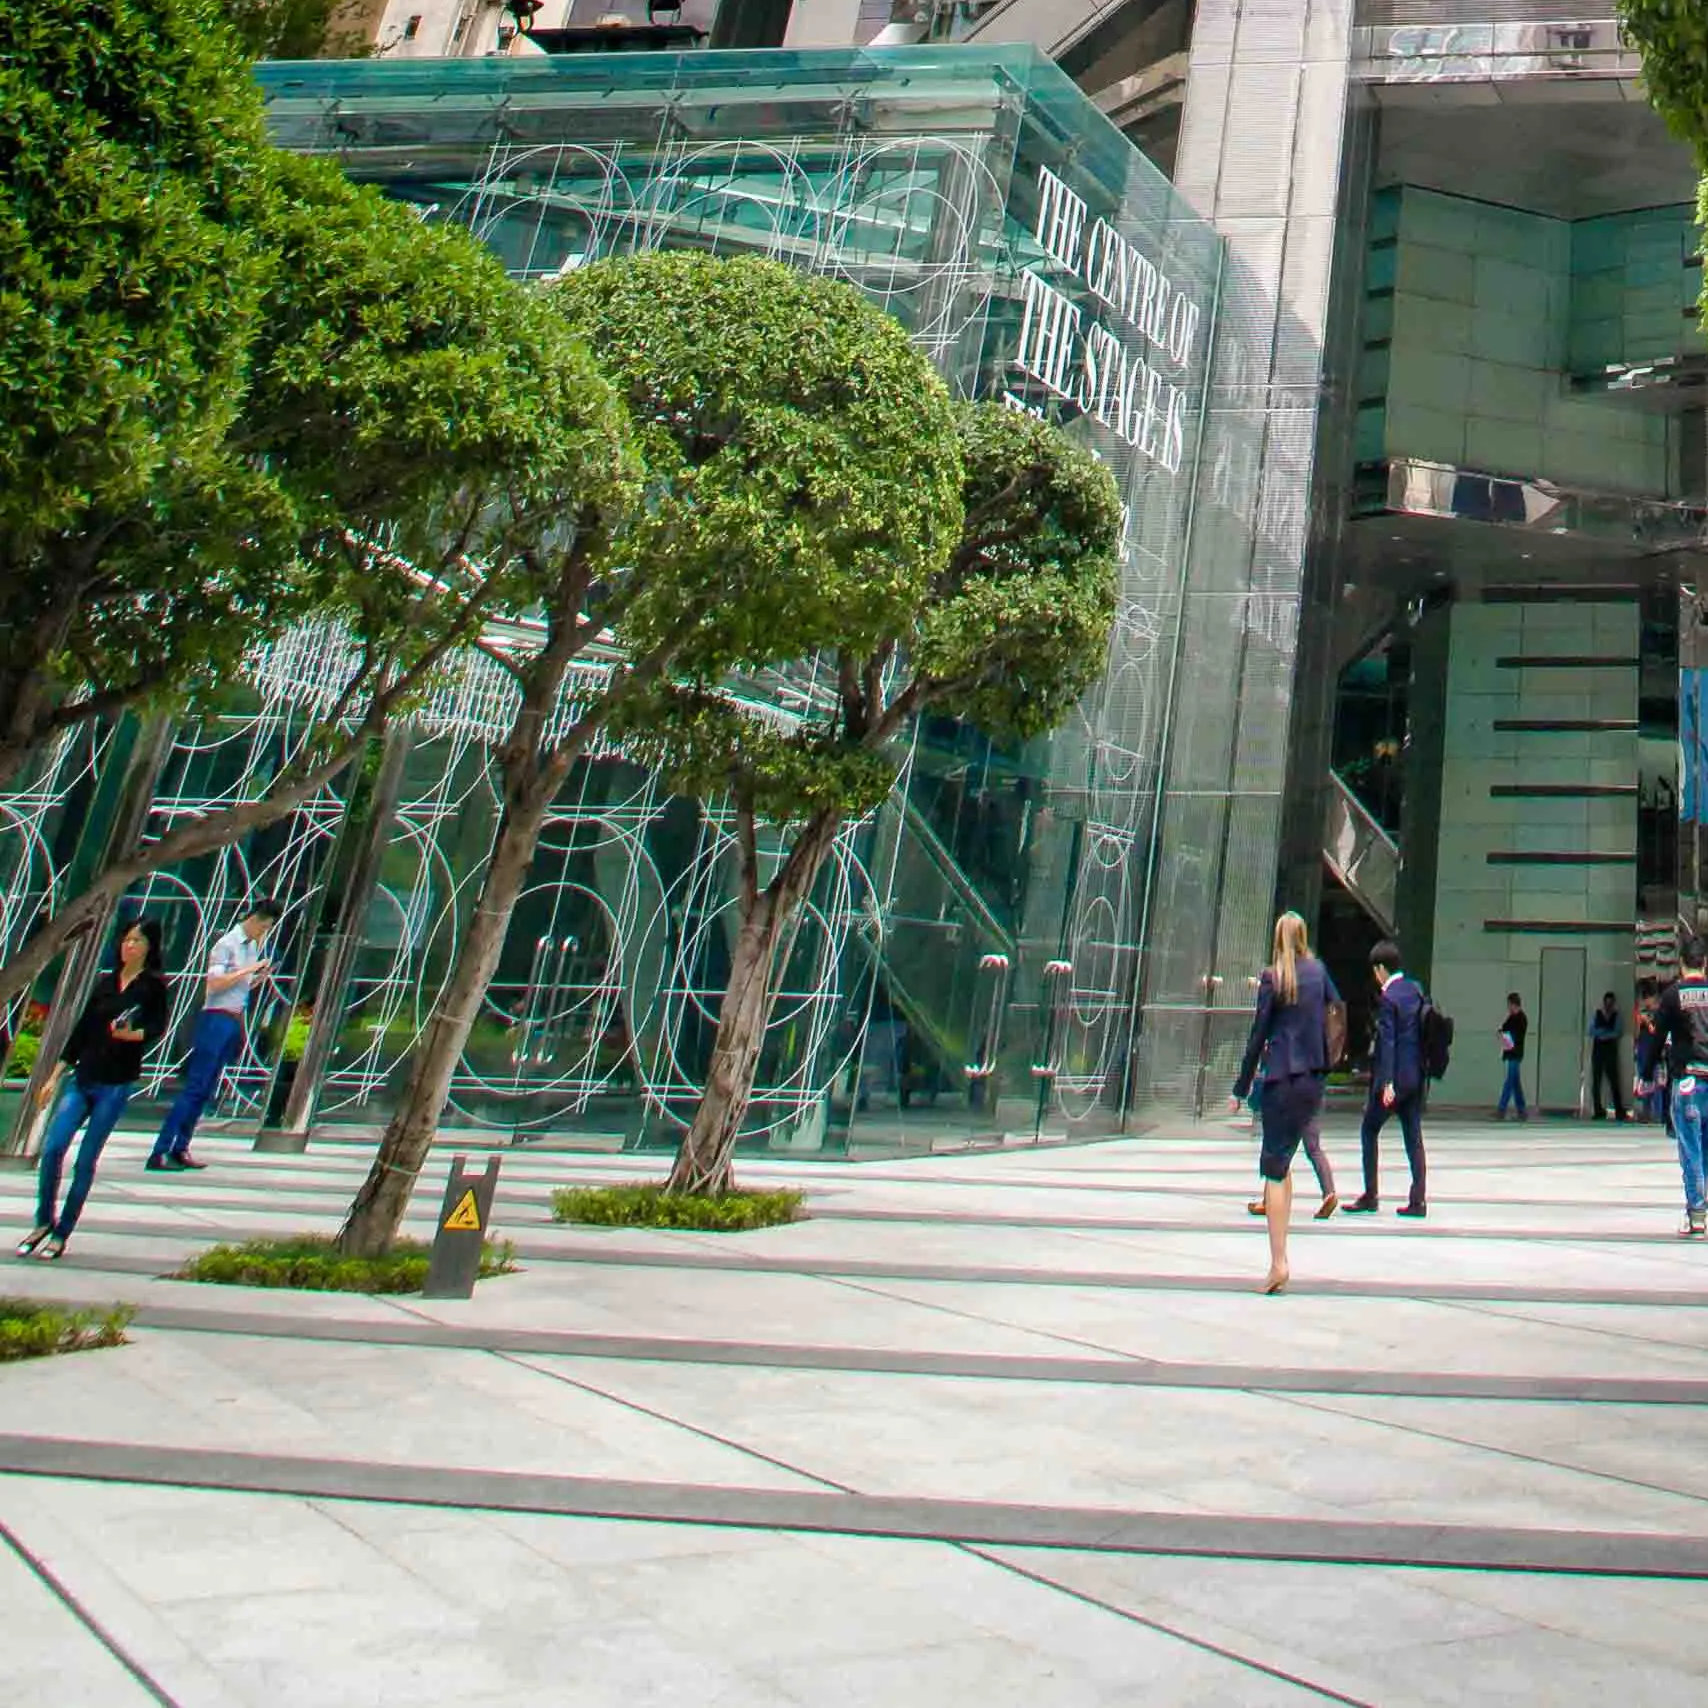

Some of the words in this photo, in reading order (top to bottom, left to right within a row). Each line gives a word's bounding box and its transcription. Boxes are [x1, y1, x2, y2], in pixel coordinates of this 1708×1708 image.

[1035, 164, 1087, 278] THE
[1086, 216, 1171, 350] CENTRE
[1169, 291, 1200, 369] OF
[1014, 267, 1082, 400] THE
[1077, 321, 1163, 459] STAGE
[1160, 383, 1188, 473] IS
